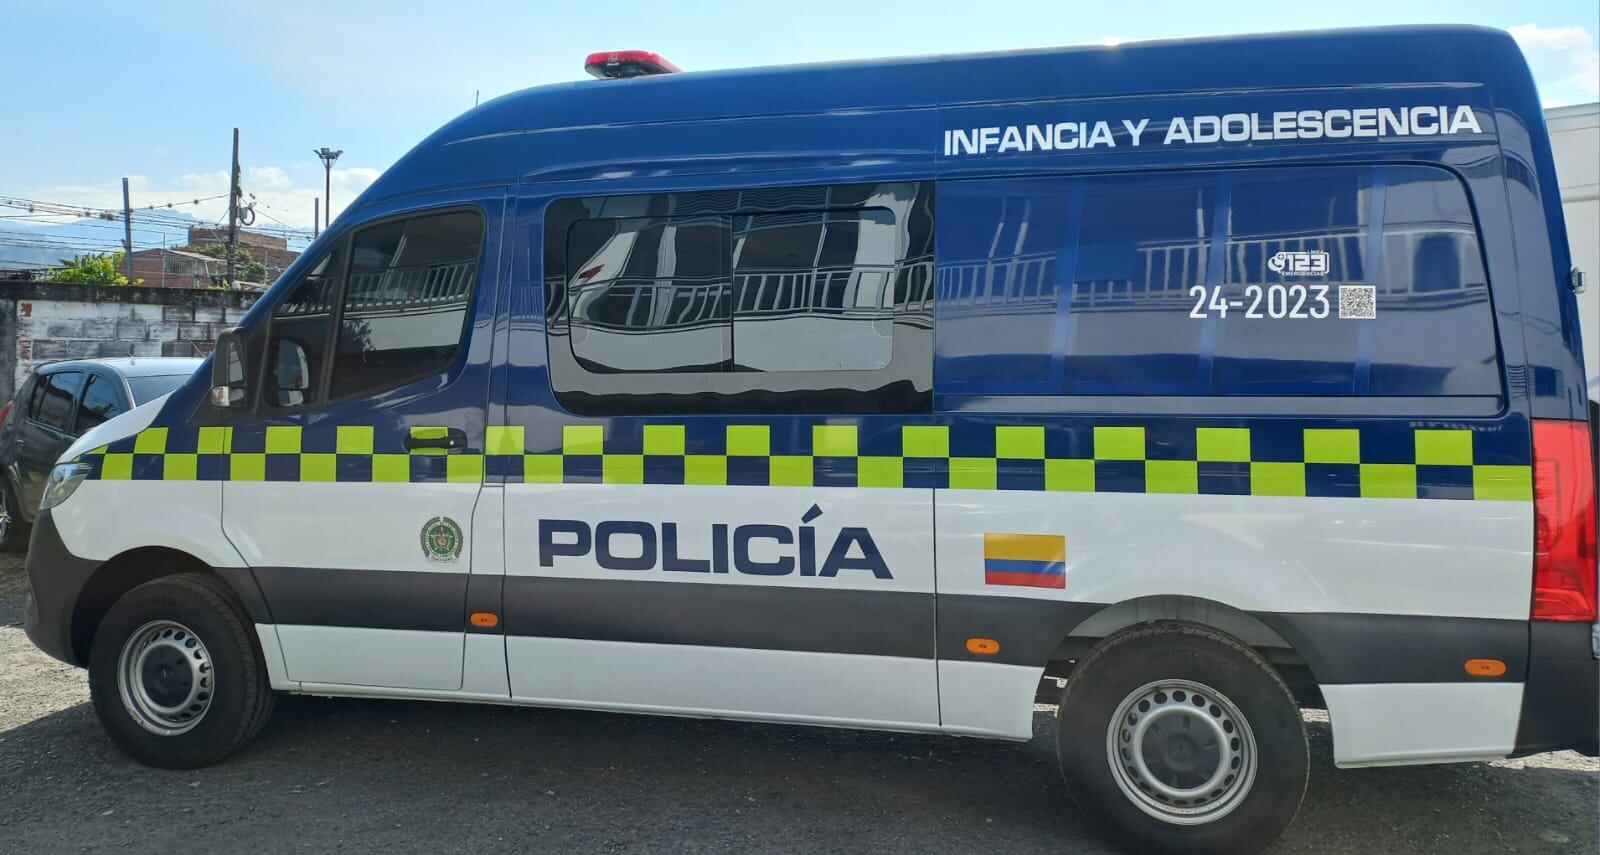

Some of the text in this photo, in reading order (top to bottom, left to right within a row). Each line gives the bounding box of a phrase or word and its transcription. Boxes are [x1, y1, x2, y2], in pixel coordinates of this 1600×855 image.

[944, 105, 1482, 156] INFANCIA Y ADOLESCENCIA
[1286, 254, 1326, 272] 123
[1189, 284, 1330, 319] 24-2023
[538, 503, 894, 580] POLICÍA
